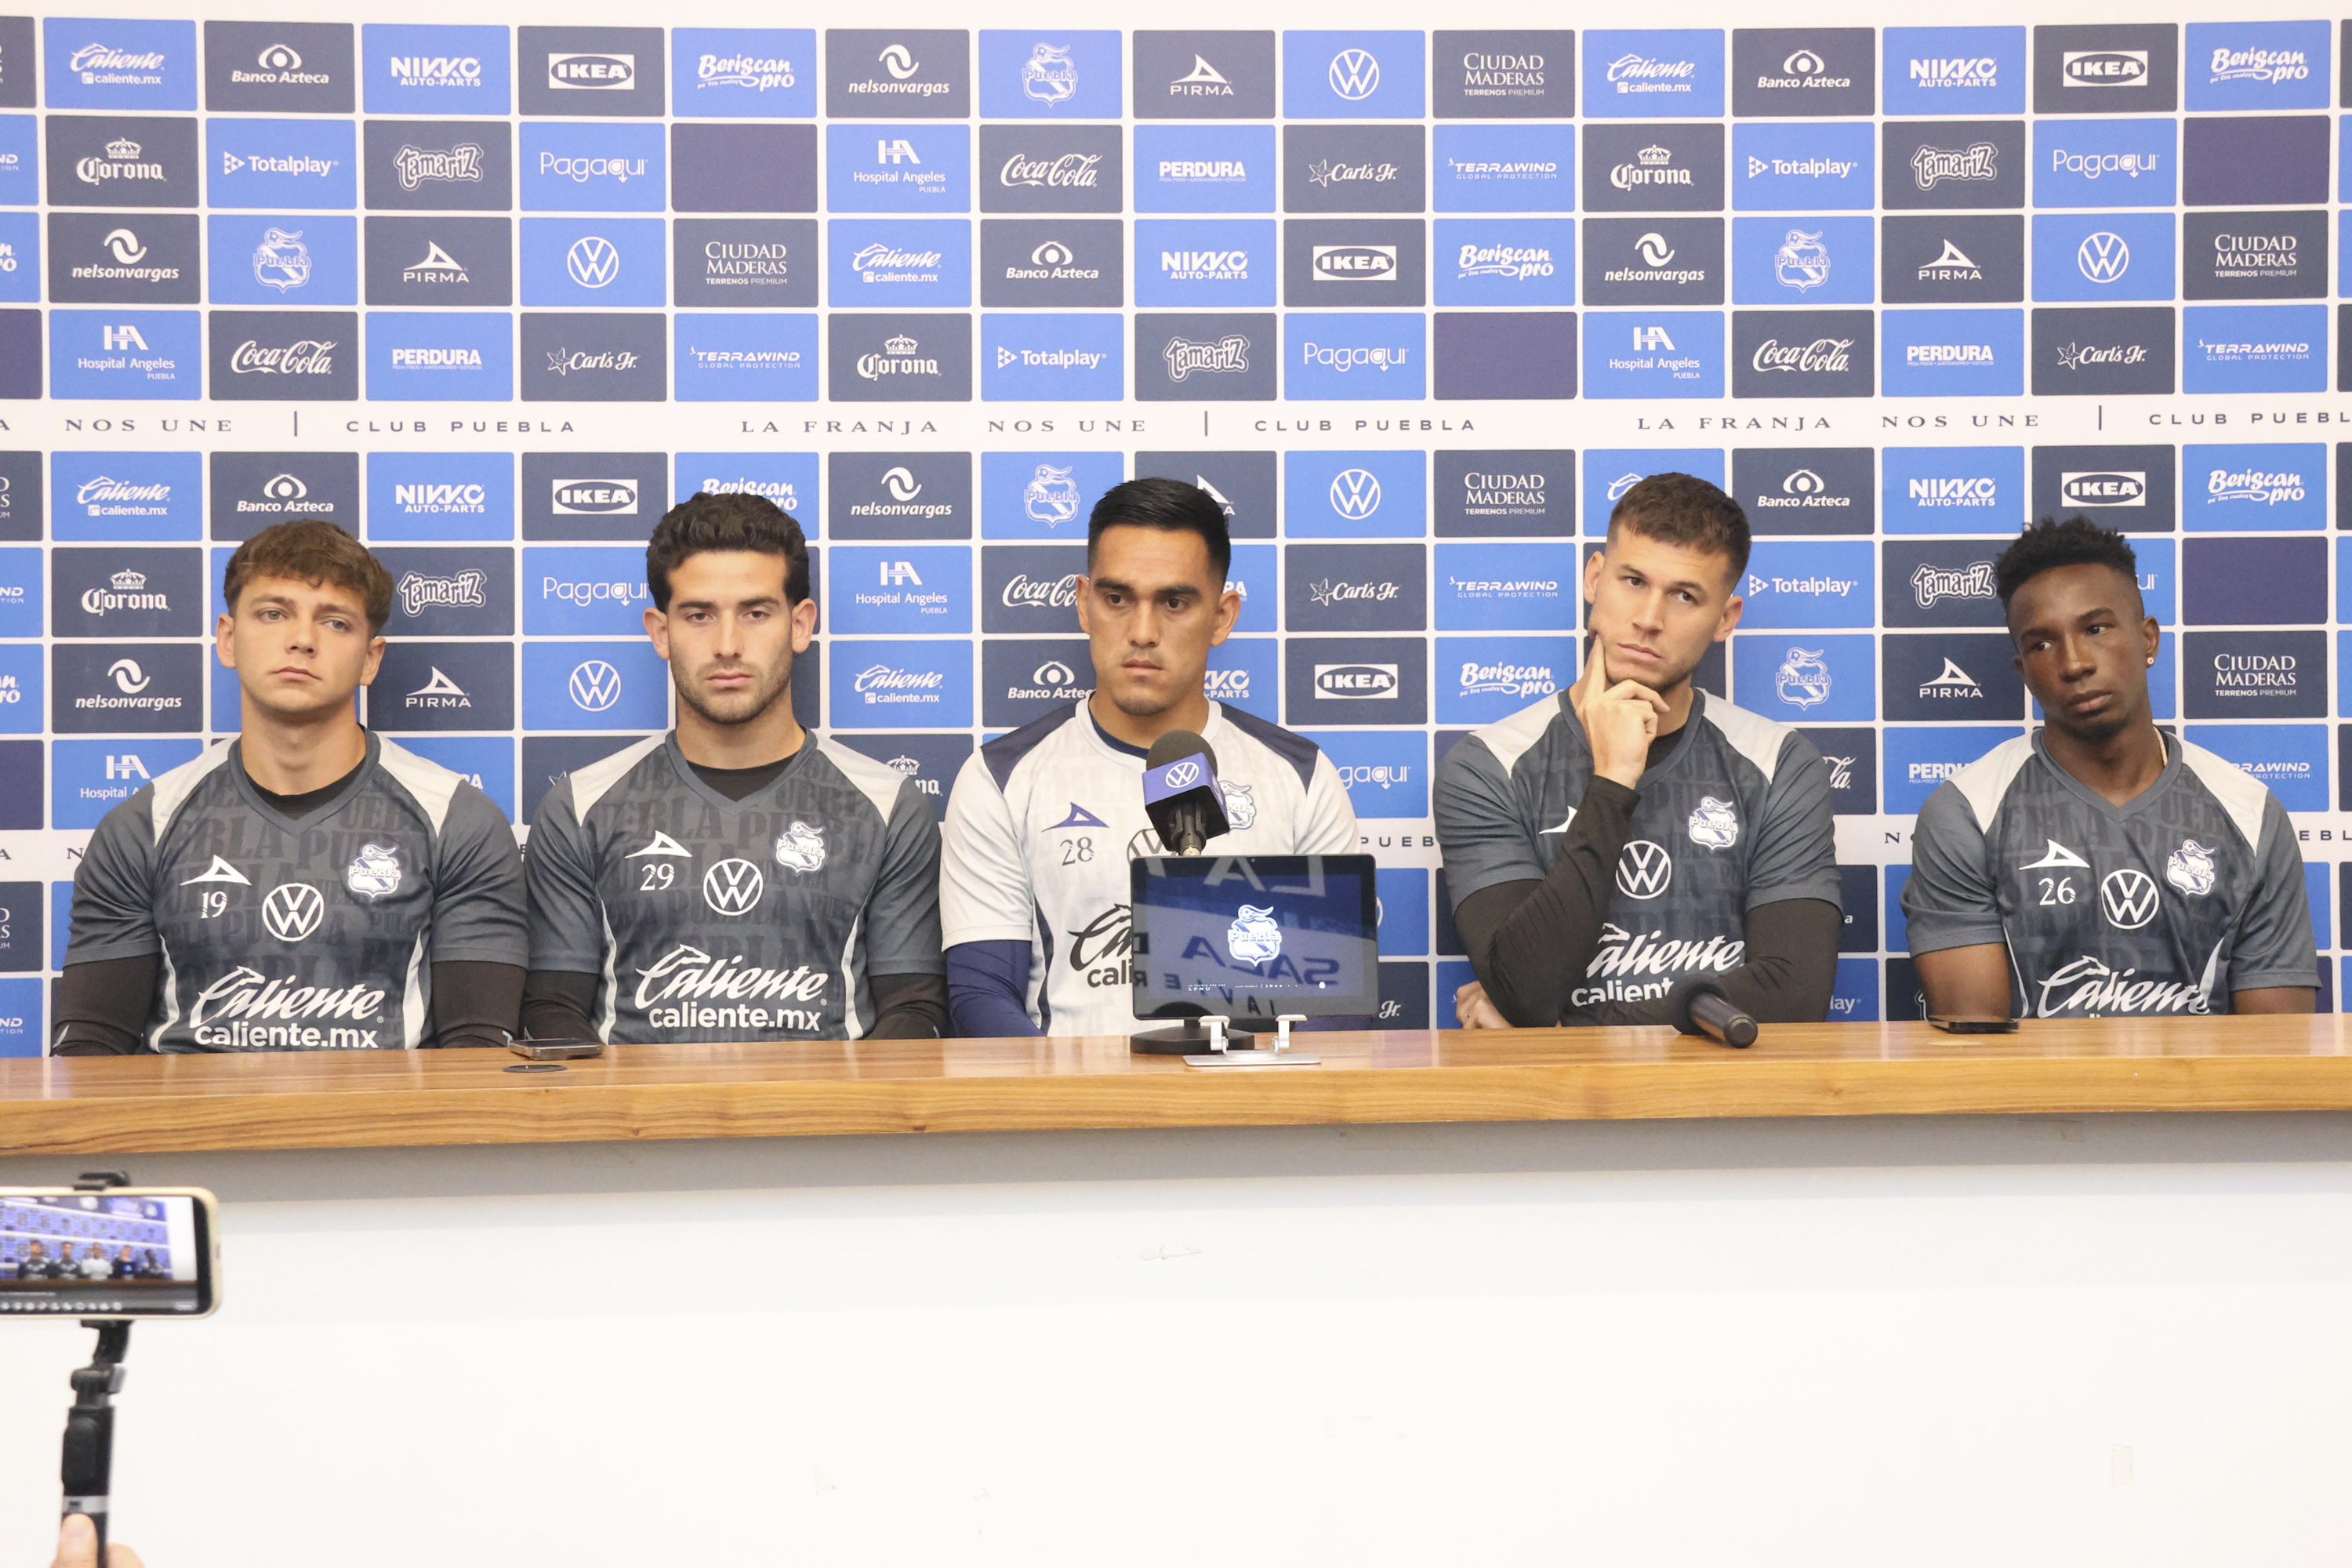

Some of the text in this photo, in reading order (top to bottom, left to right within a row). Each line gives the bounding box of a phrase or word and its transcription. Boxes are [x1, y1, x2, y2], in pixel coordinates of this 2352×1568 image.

[71, 43, 165, 71] Caliente
[390, 56, 481, 79] NIKKO
[557, 63, 627, 80] IKEA
[1023, 67, 1077, 83] Puebla
[1607, 53, 1694, 82] Caliente
[1909, 57, 1996, 79] NIKKO
[2070, 60, 2143, 77] IKEA
[92, 73, 162, 84] caliente.mx
[232, 71, 329, 83] Banco Azteca
[399, 78, 481, 87] AUTO-PARTS
[759, 71, 795, 93] pro
[1918, 78, 1997, 88] AUTO-PARTS
[849, 79, 949, 96] nelsonvargas
[1171, 85, 1233, 95] PIRMA
[1629, 82, 1691, 92] caliente.mx
[77, 158, 164, 185] Corona
[248, 156, 332, 176] Totalplay
[1001, 154, 1102, 187] Coca-Cola
[1160, 162, 1245, 177] PERDURA
[1455, 163, 1556, 172] TERRAWIND
[1772, 158, 1851, 178] Totalplay
[854, 171, 946, 185] Hospital Angeles
[1610, 164, 1691, 191] Corona
[255, 252, 310, 270] Puebla
[1777, 254, 1831, 270] Puebla
[72, 264, 179, 282] nelsonvargas
[1006, 267, 1098, 278] Banco Azteca
[1918, 270, 1982, 280] PIRMA
[231, 340, 337, 374] Coca-Cola
[393, 349, 481, 365] PERDURA
[567, 352, 637, 370] Carl's Jr.
[697, 352, 800, 361] TERRAWIND
[1753, 339, 1854, 372] Coca-Cola
[1907, 346, 1993, 361] PERDURA
[2077, 346, 2147, 364] Carl's Jr.
[78, 358, 175, 372] Hospital Angeles
[1610, 358, 1700, 371] Hospital Angeles
[66, 419, 230, 431] NOS UNE
[347, 421, 573, 432] CLUB PUEBLA
[1255, 420, 1474, 431] CLUB PUEBLA
[1639, 416, 2038, 430] LA FRANJA NOS UNE
[2150, 412, 2351, 425] CLUB PUEBL
[742, 421, 1144, 435] LA FRANJA NOS UNE
[77, 476, 170, 504] Caliente
[394, 482, 485, 505] NIKKO
[561, 488, 630, 504] IKEA
[1908, 477, 1996, 499] NIKKO
[2069, 479, 2143, 496] IKEA
[2269, 486, 2305, 506] pro
[237, 501, 334, 512] Banco Azteca
[405, 503, 485, 514] AUTO-PARTS
[1758, 495, 1849, 506] Banco Azteca
[1918, 498, 1997, 507] AUTO-PARTS
[98, 505, 167, 516] caliente.mx
[851, 502, 952, 518] nelsonvargas
[1002, 574, 1078, 608] Coca-Co
[1329, 583, 1399, 601] Carl's Jr.
[1456, 581, 1557, 590] TERRAWIND
[1772, 577, 1851, 596] Totalplay
[82, 588, 168, 616] Corona
[856, 592, 947, 606] Hospital Angeles
[855, 664, 942, 692] Caliente
[1322, 673, 1392, 690] IKEA
[1777, 672, 1832, 688] Puebla
[877, 693, 939, 702] caliente.mx
[1008, 688, 1051, 699] Banco
[1520, 679, 1555, 699] pro
[1920, 688, 1983, 698] PIRMA
[76, 695, 181, 711] nelsonvargas
[406, 698, 471, 707] PIRMA
[1338, 765, 1407, 790] gaqui
[1908, 763, 1970, 779] PERD
[81, 786, 127, 800] Hospital
[1689, 815, 1738, 833] Puebla
[777, 838, 826, 859] Puebla
[1360, 837, 1435, 847] PUEB
[1059, 836, 1094, 866] 28
[348, 865, 401, 879] Puebla
[640, 863, 675, 891] 29
[2168, 855, 2216, 882] Puebla
[2038, 877, 2076, 906] 26
[201, 891, 227, 919] 19
[1229, 929, 1281, 942] Puebla
[634, 943, 829, 1010] Caliente
[189, 965, 386, 1029] Caliente
[1571, 977, 1674, 1007] calient
[648, 1001, 822, 1032] caliente.mx
[1379, 1000, 1401, 1018] Jr.
[194, 1021, 379, 1049] caliente.mx
